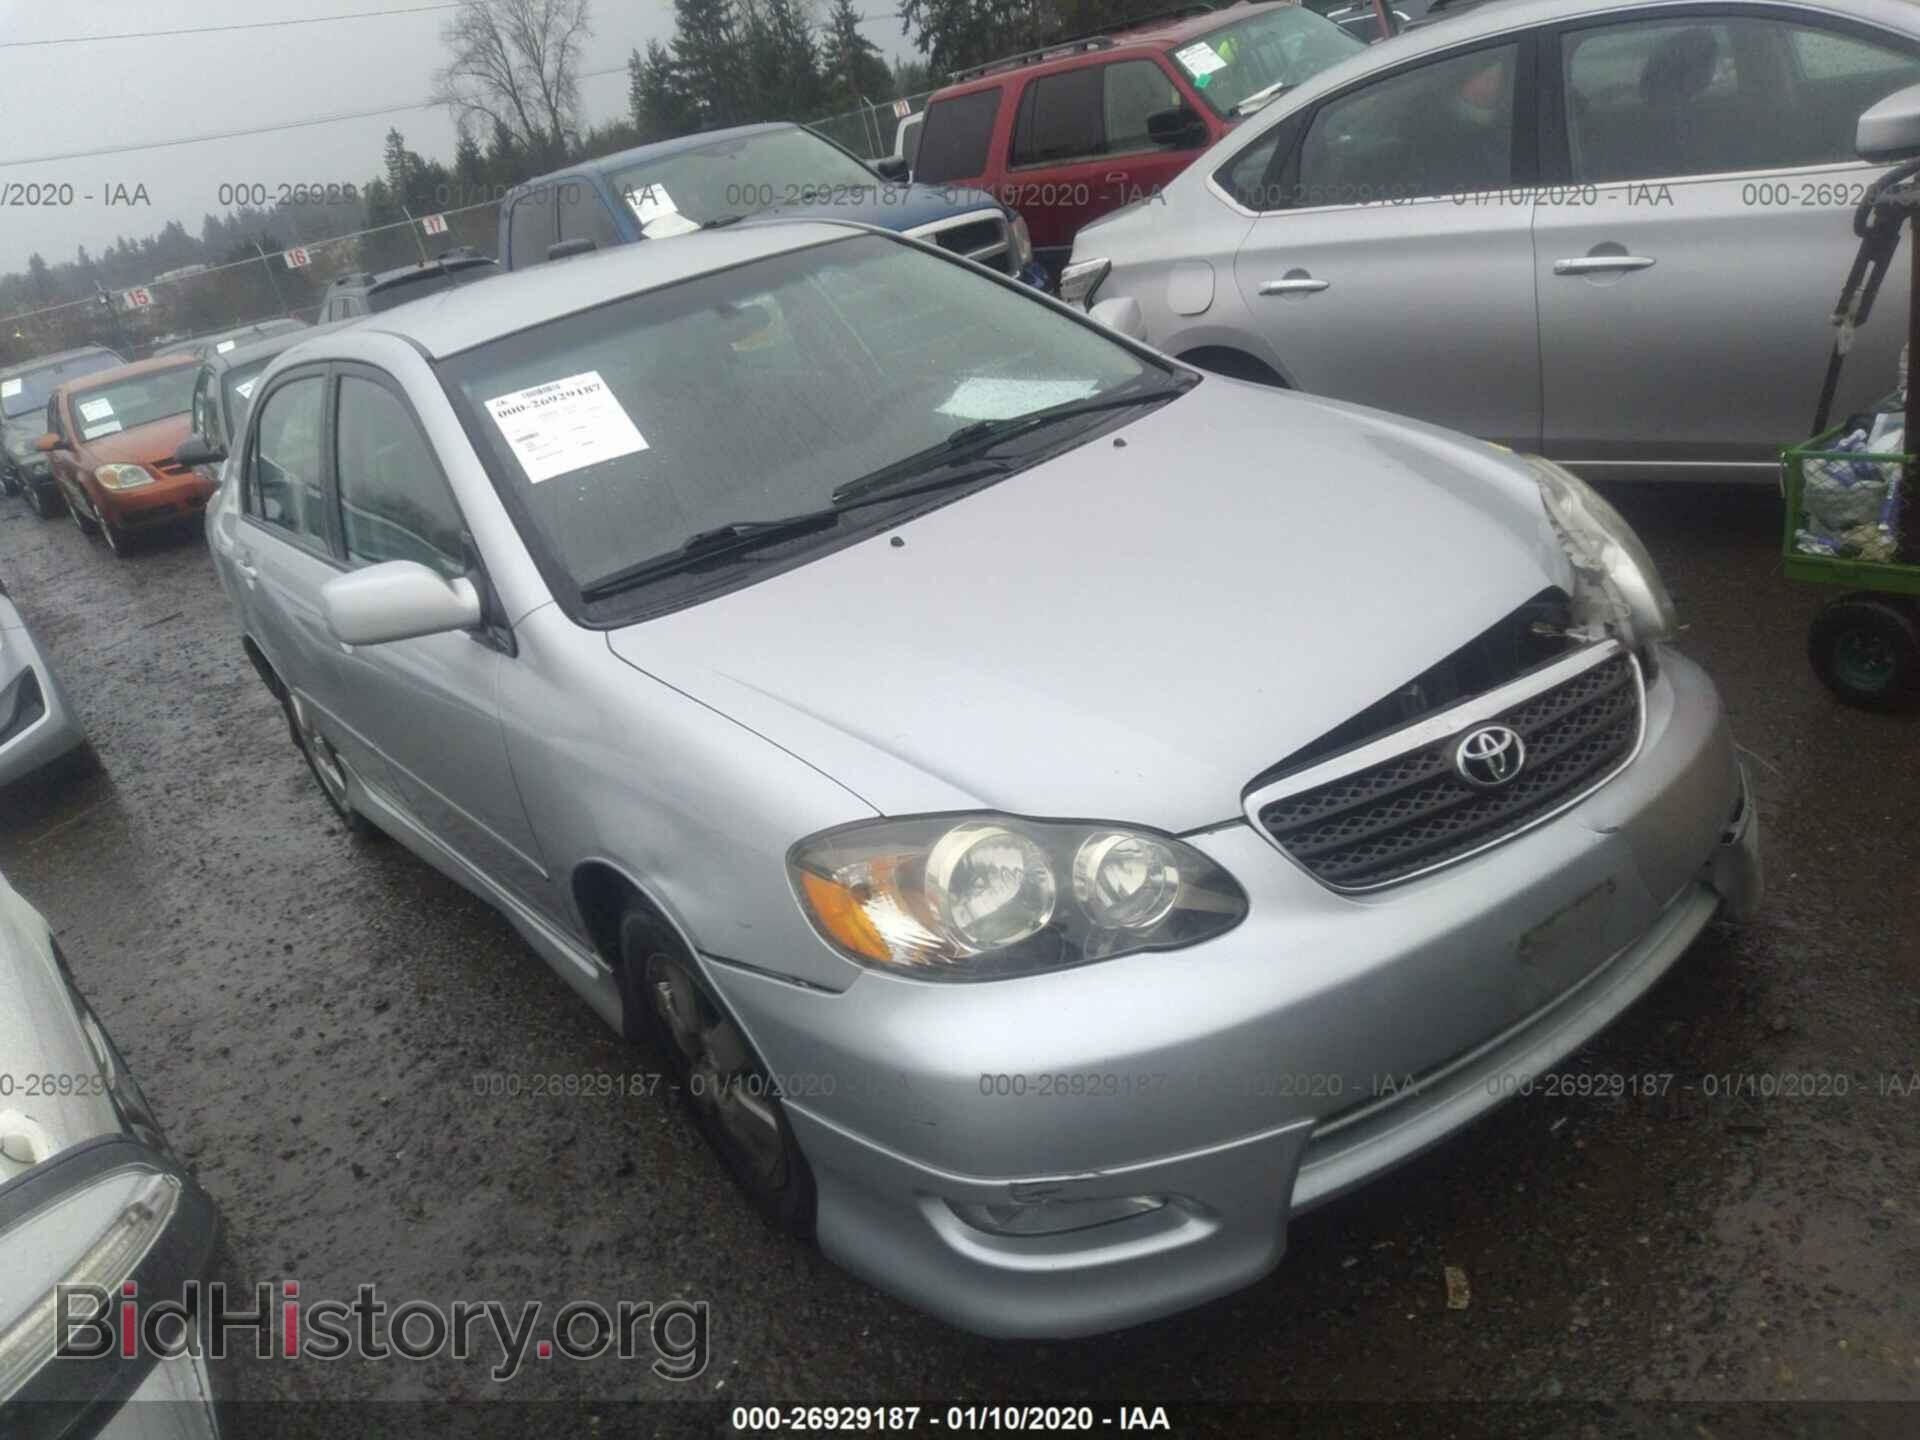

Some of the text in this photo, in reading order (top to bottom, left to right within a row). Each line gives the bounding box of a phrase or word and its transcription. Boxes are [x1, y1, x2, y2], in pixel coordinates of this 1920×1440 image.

[427, 215, 442, 233] 17
[287, 248, 306, 267] 16
[128, 288, 150, 306] 15
